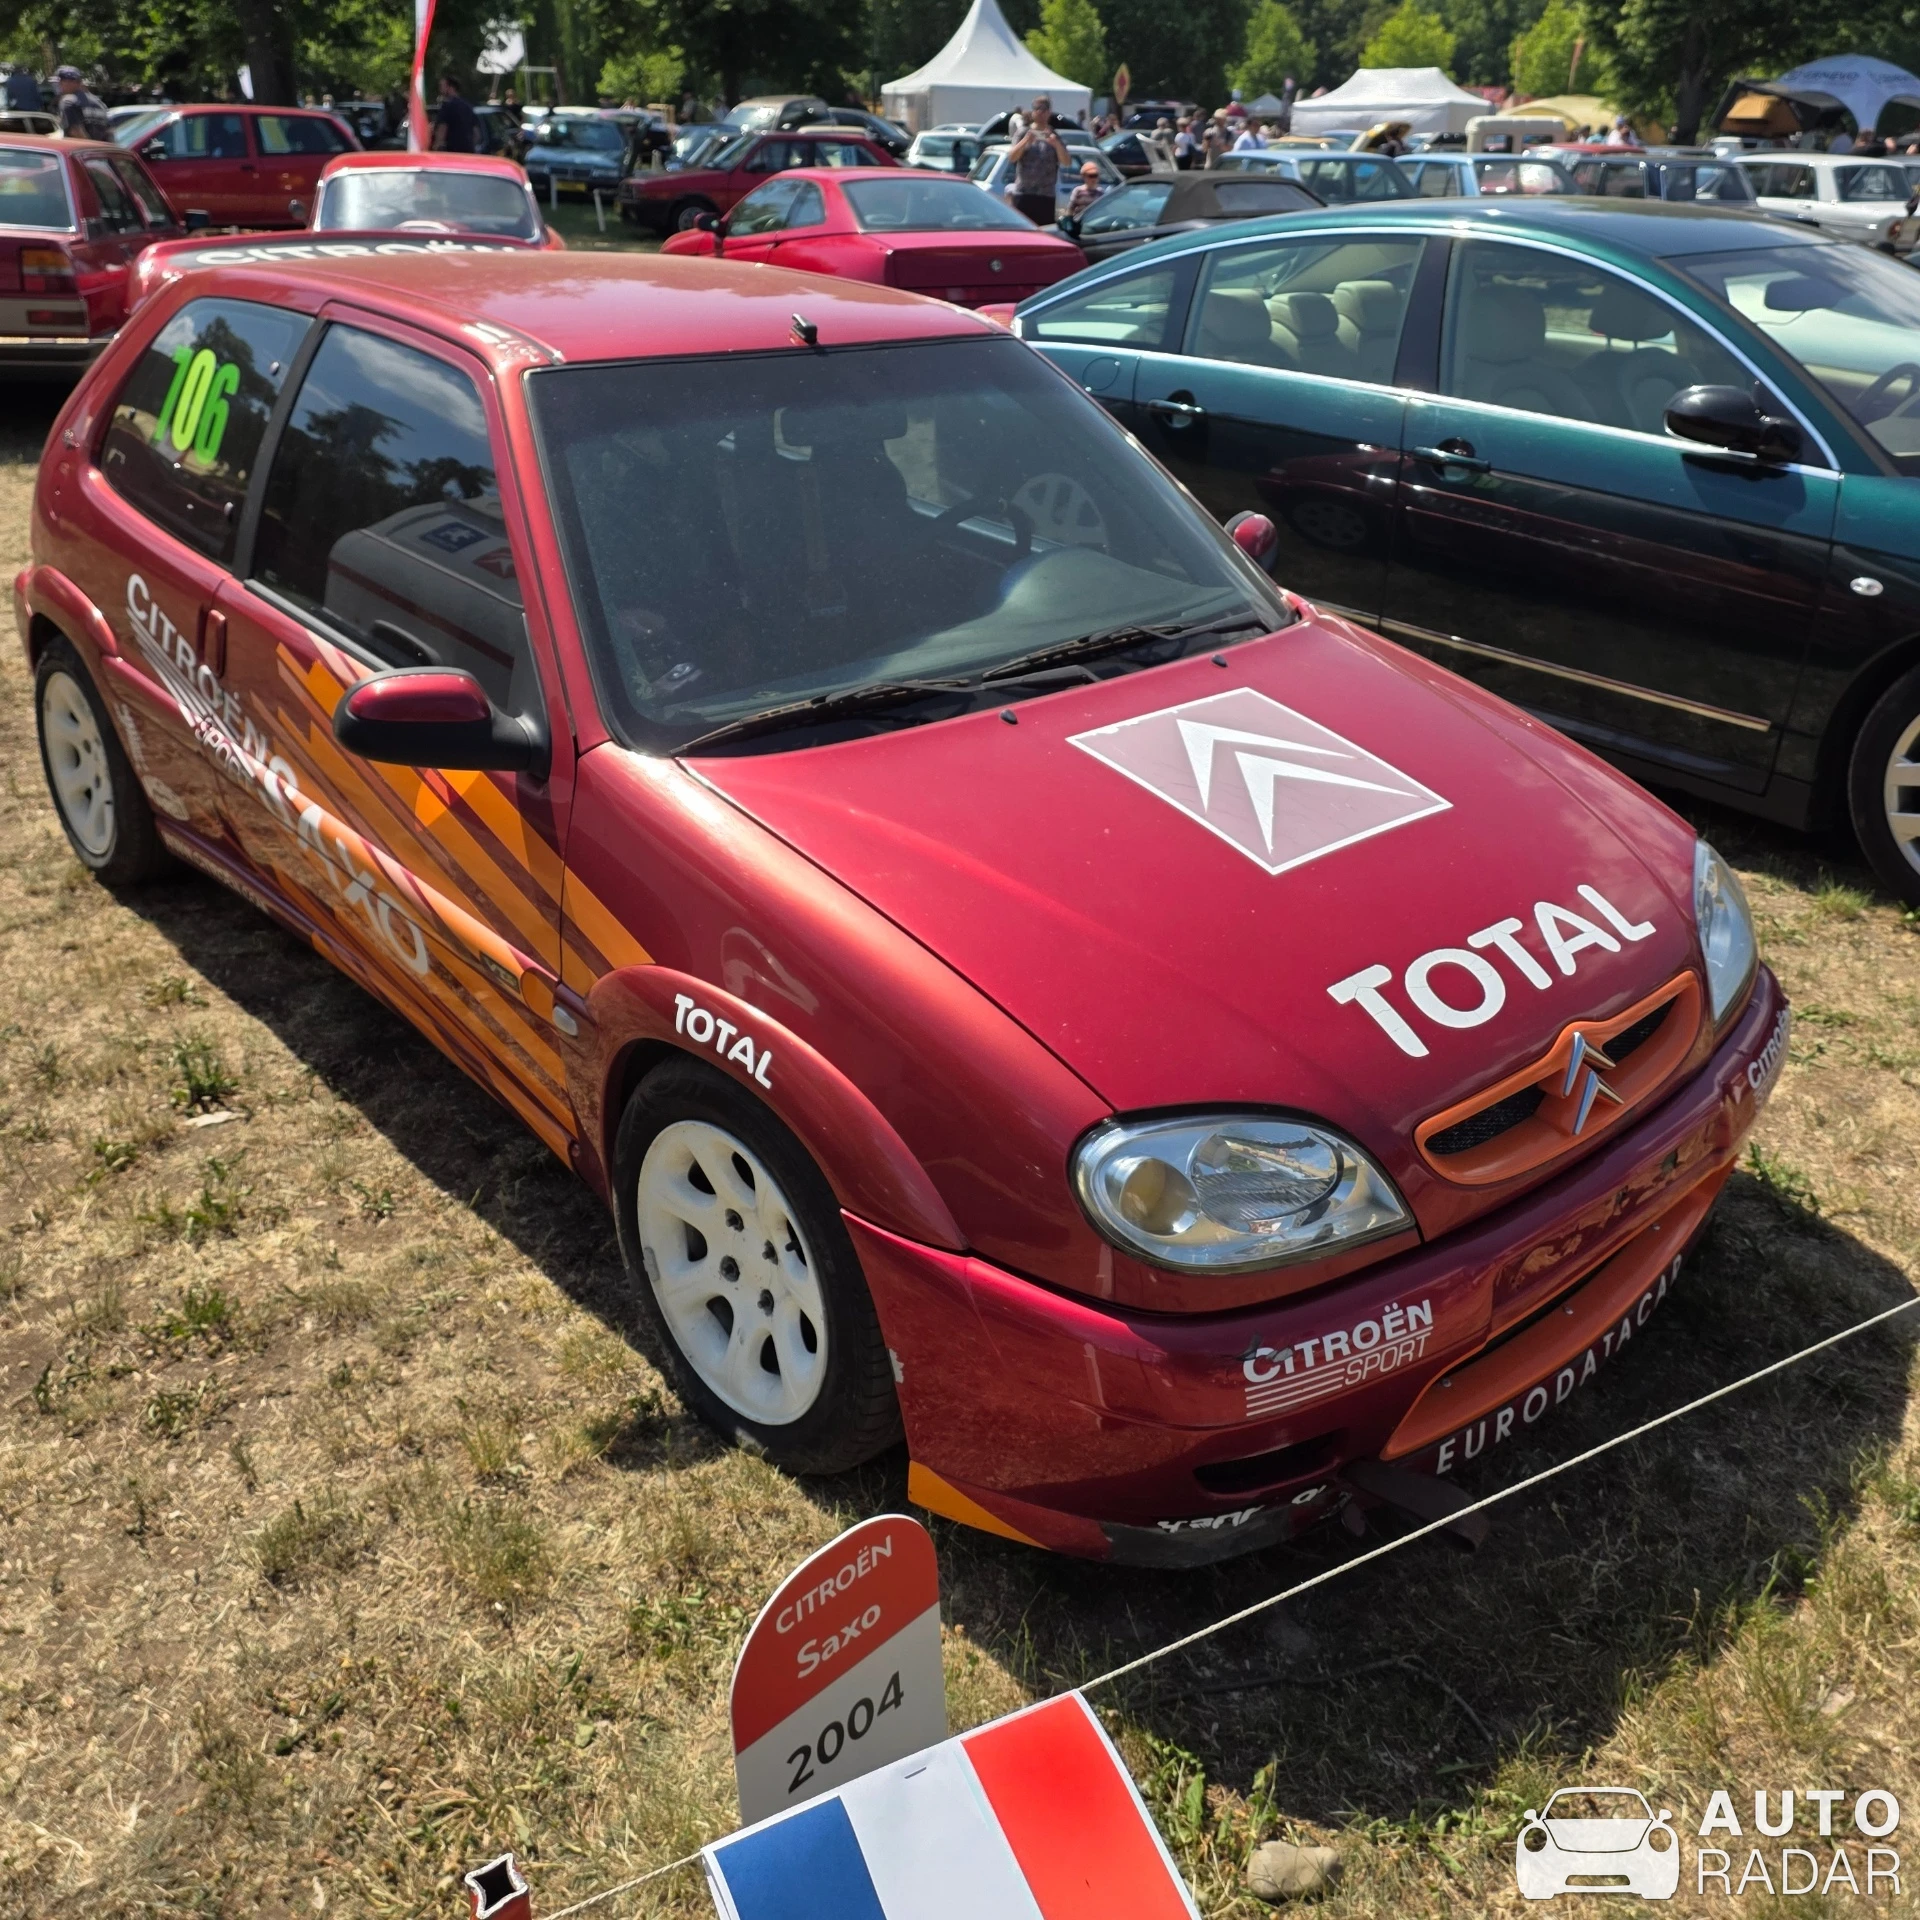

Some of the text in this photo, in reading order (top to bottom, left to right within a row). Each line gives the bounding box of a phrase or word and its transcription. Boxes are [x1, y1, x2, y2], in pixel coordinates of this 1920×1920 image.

[154, 343, 240, 465] 106
[126, 573, 267, 765] CITROËN
[257, 755, 429, 975] SAXO
[1326, 884, 1657, 1058] TOTAL
[674, 992, 773, 1090] TOTAL
[1243, 1298, 1434, 1383] CITROËN
[1344, 1334, 1432, 1386] SPORT
[775, 1534, 893, 1635] CITROËN
[796, 1603, 881, 1679] Saxo
[786, 1670, 905, 1795] 2004
